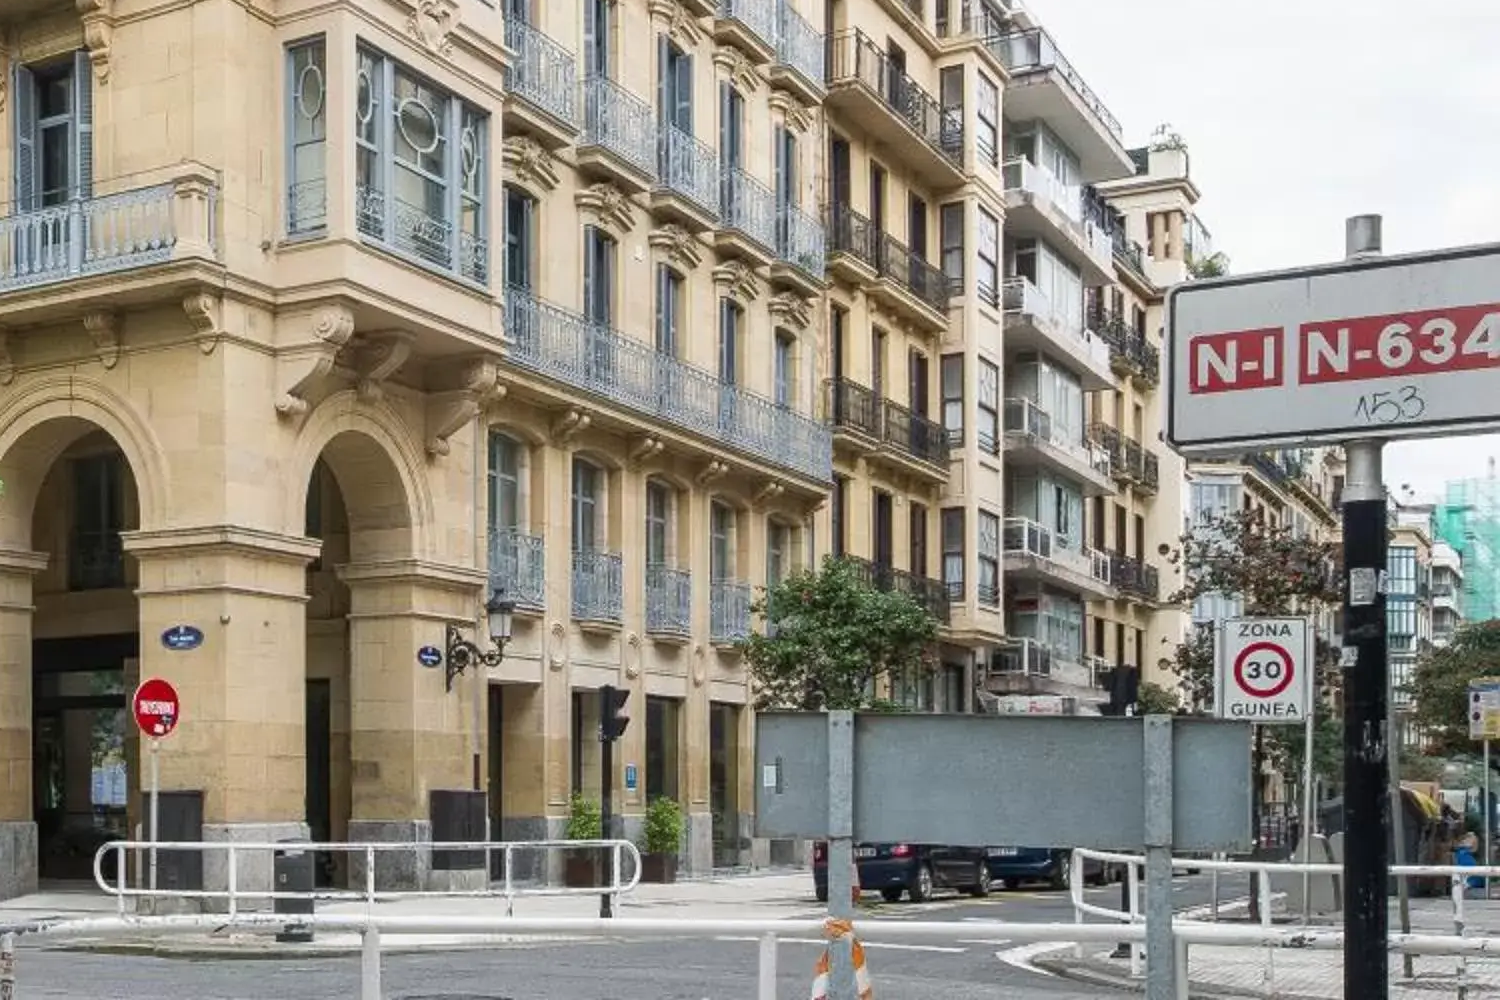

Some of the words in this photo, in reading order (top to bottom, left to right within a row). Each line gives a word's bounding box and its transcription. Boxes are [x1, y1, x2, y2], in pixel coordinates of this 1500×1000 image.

[1307, 312, 1500, 376] N-634
[1354, 385, 1425, 424] 153
[1239, 623, 1292, 637] ZONA
[1246, 661, 1281, 679] 30
[1231, 703, 1298, 717] GUNEA
